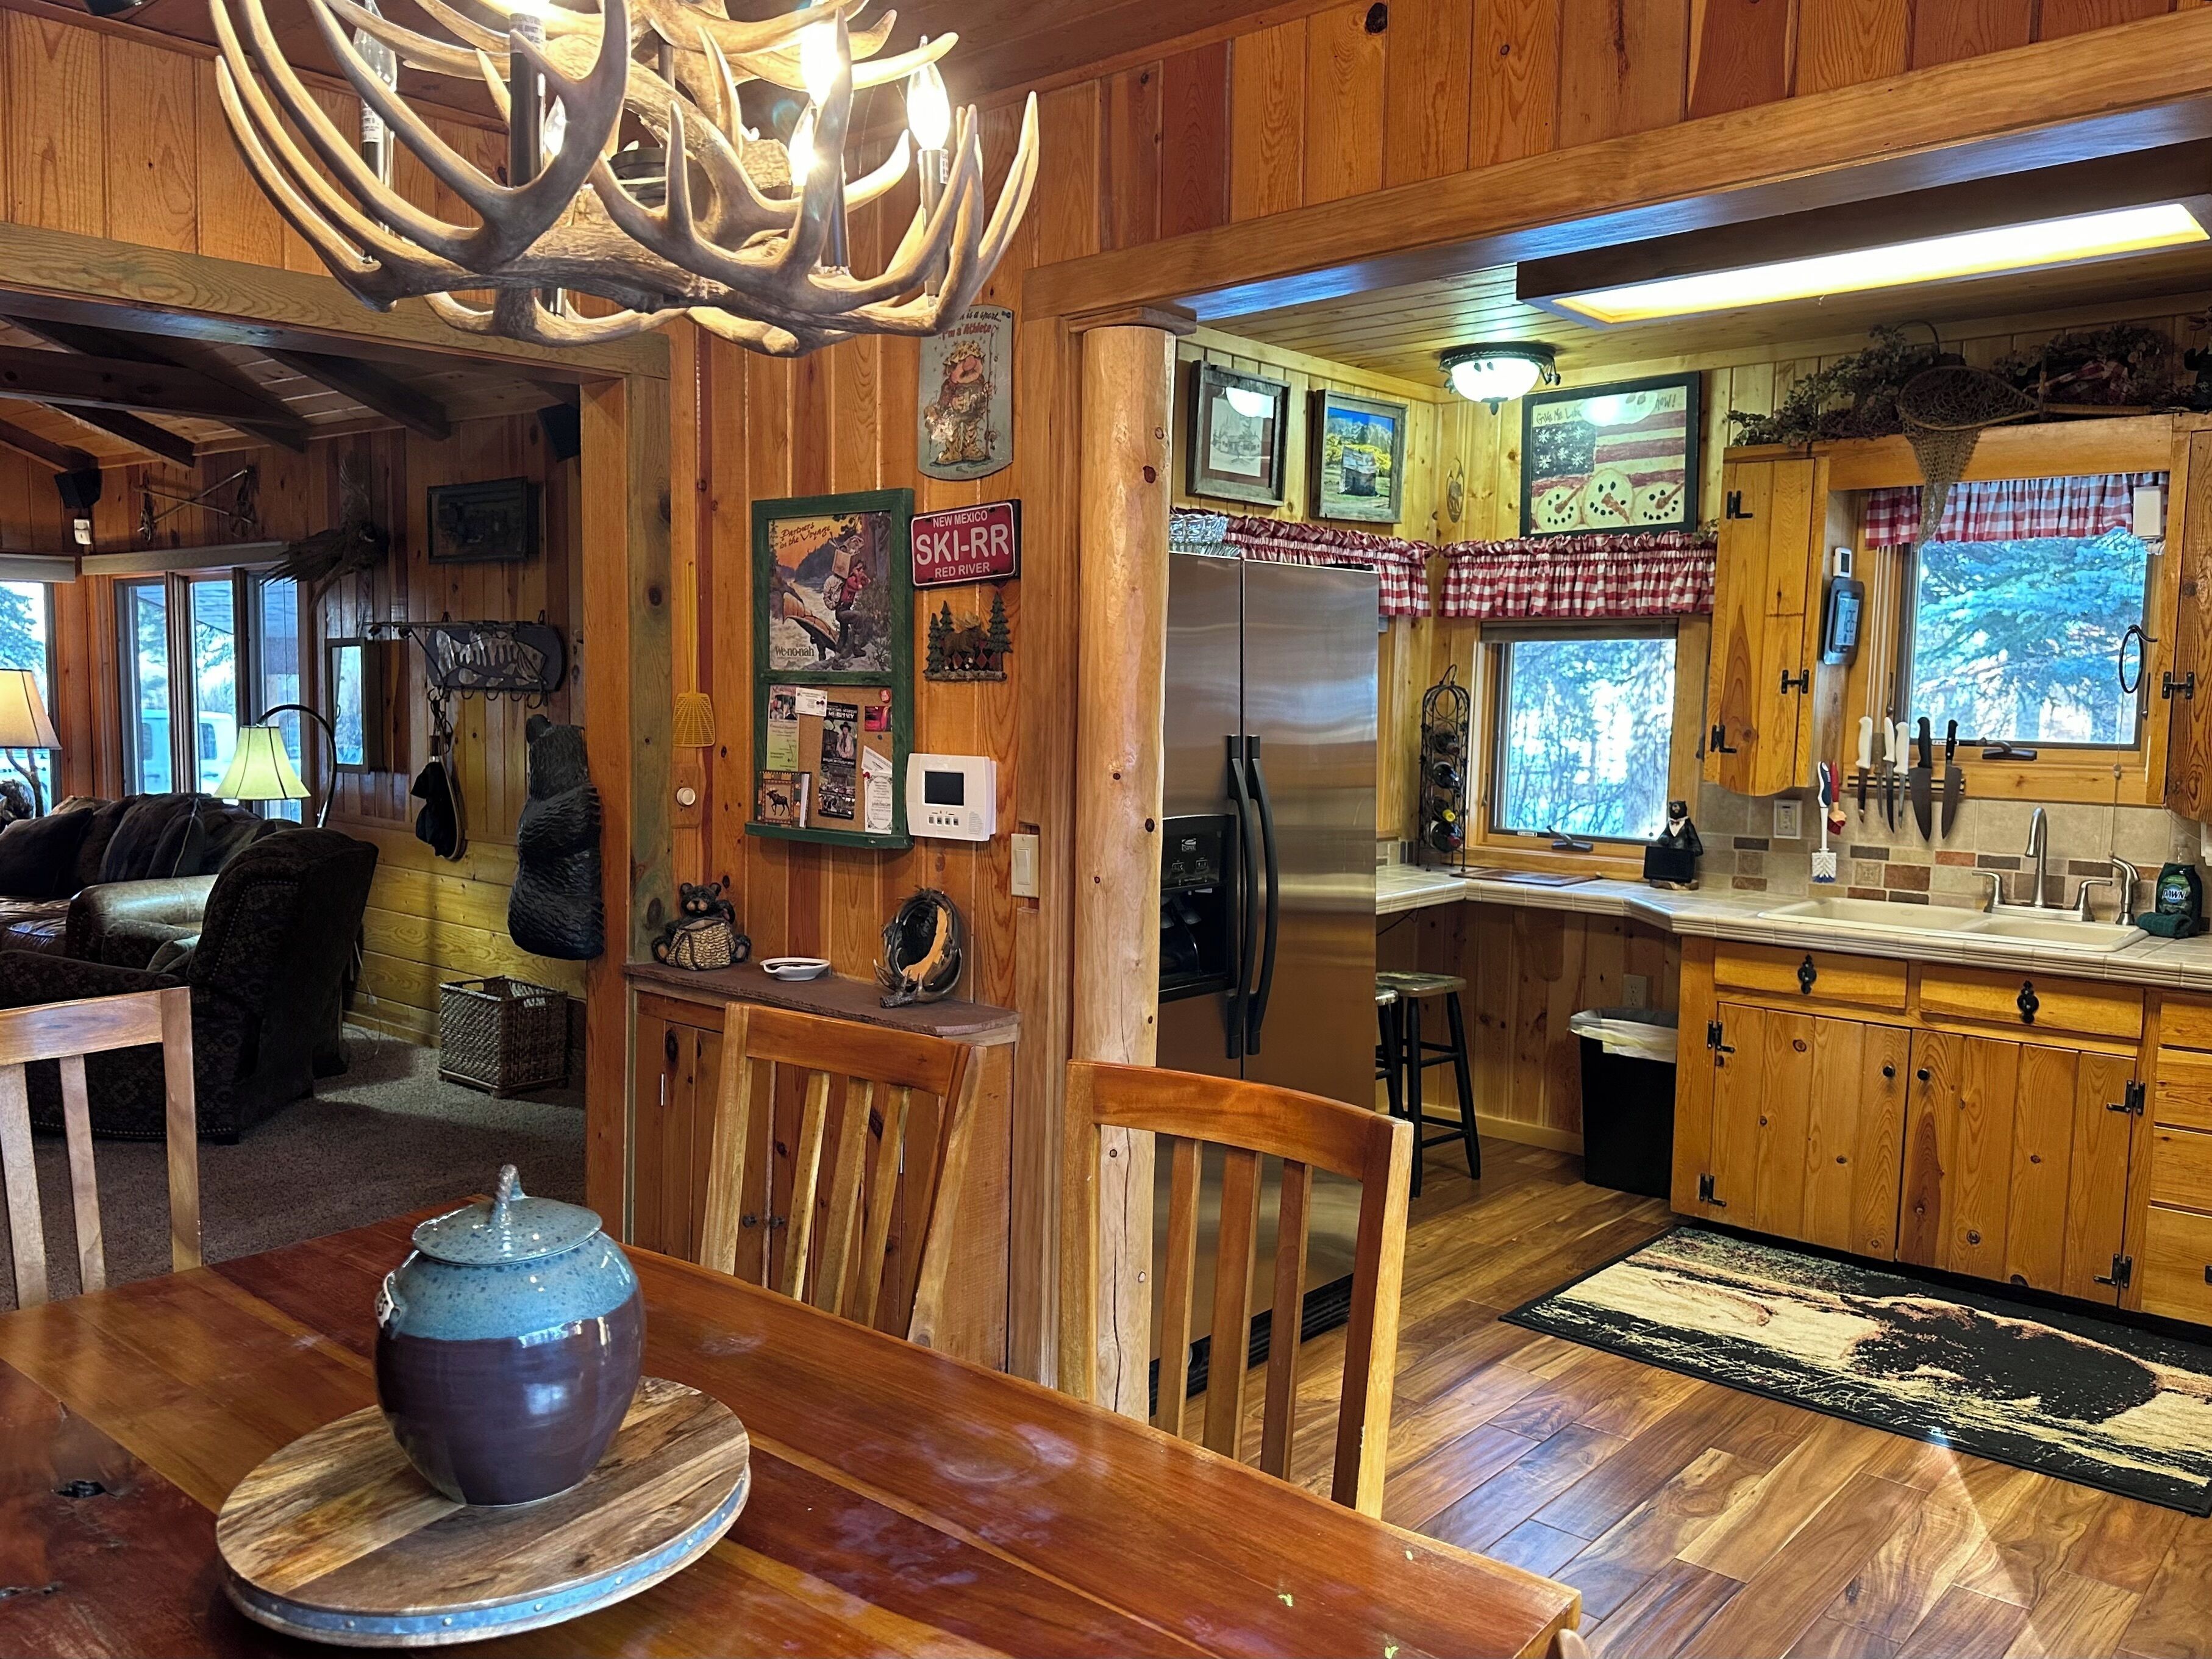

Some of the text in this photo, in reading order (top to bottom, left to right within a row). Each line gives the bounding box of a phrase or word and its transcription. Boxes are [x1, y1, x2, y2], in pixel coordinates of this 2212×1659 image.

[966, 309, 973, 319] is
[933, 510, 988, 528] NEW MEXICO
[780, 522, 815, 538] Partners
[788, 536, 799, 546] the
[800, 525, 830, 541] Voyage
[916, 523, 1010, 565] SKI-RR
[935, 562, 990, 579] RED RIVER
[2162, 888, 2186, 899] DAWN
